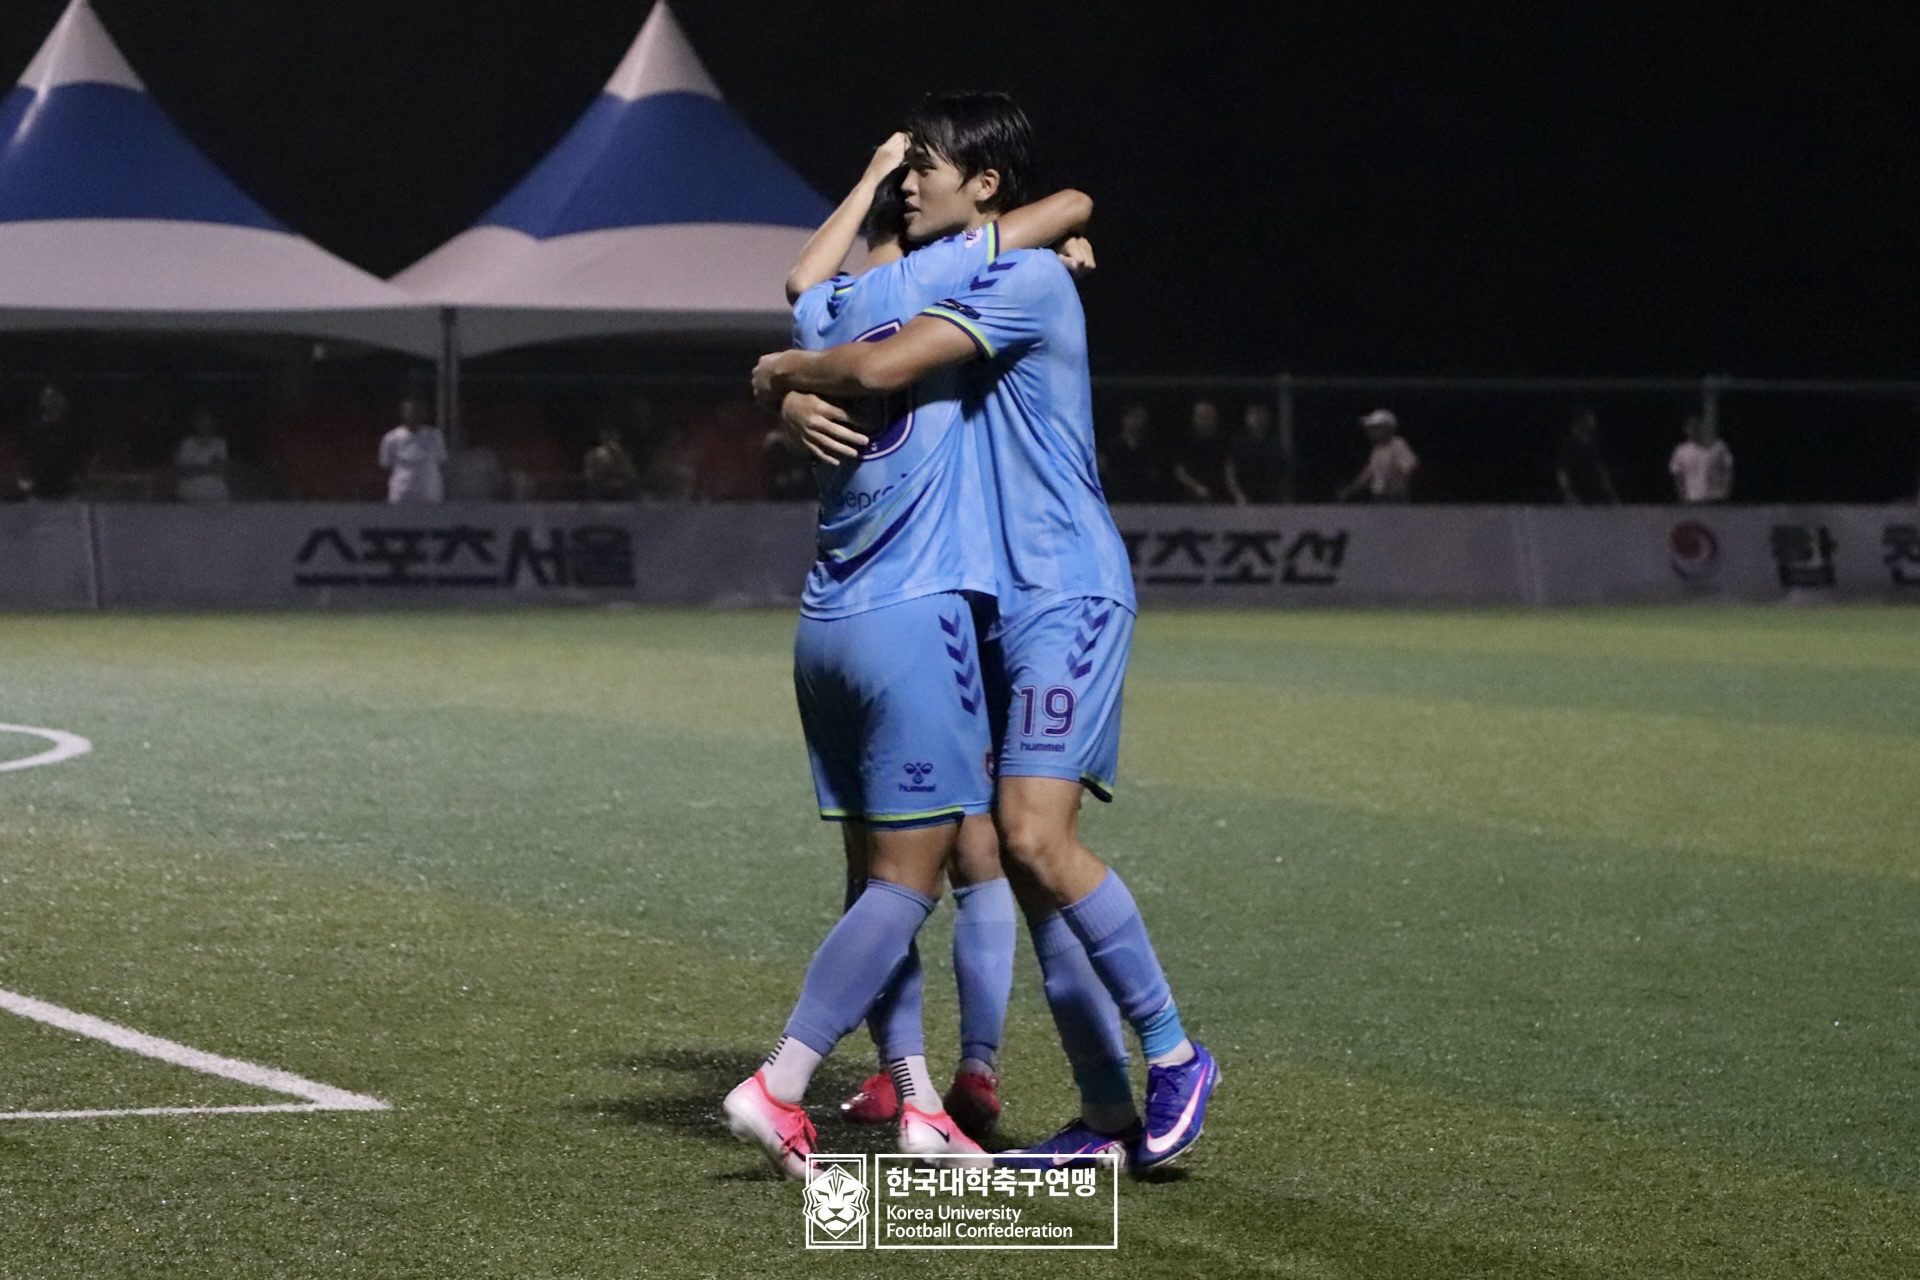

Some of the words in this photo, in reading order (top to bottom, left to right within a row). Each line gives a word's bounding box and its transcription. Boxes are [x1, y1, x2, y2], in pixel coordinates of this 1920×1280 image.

[296, 526, 637, 587] 스포츠서울
[1016, 685, 1077, 738] 19
[1020, 741, 1066, 753] hummel
[899, 783, 936, 793] hummel
